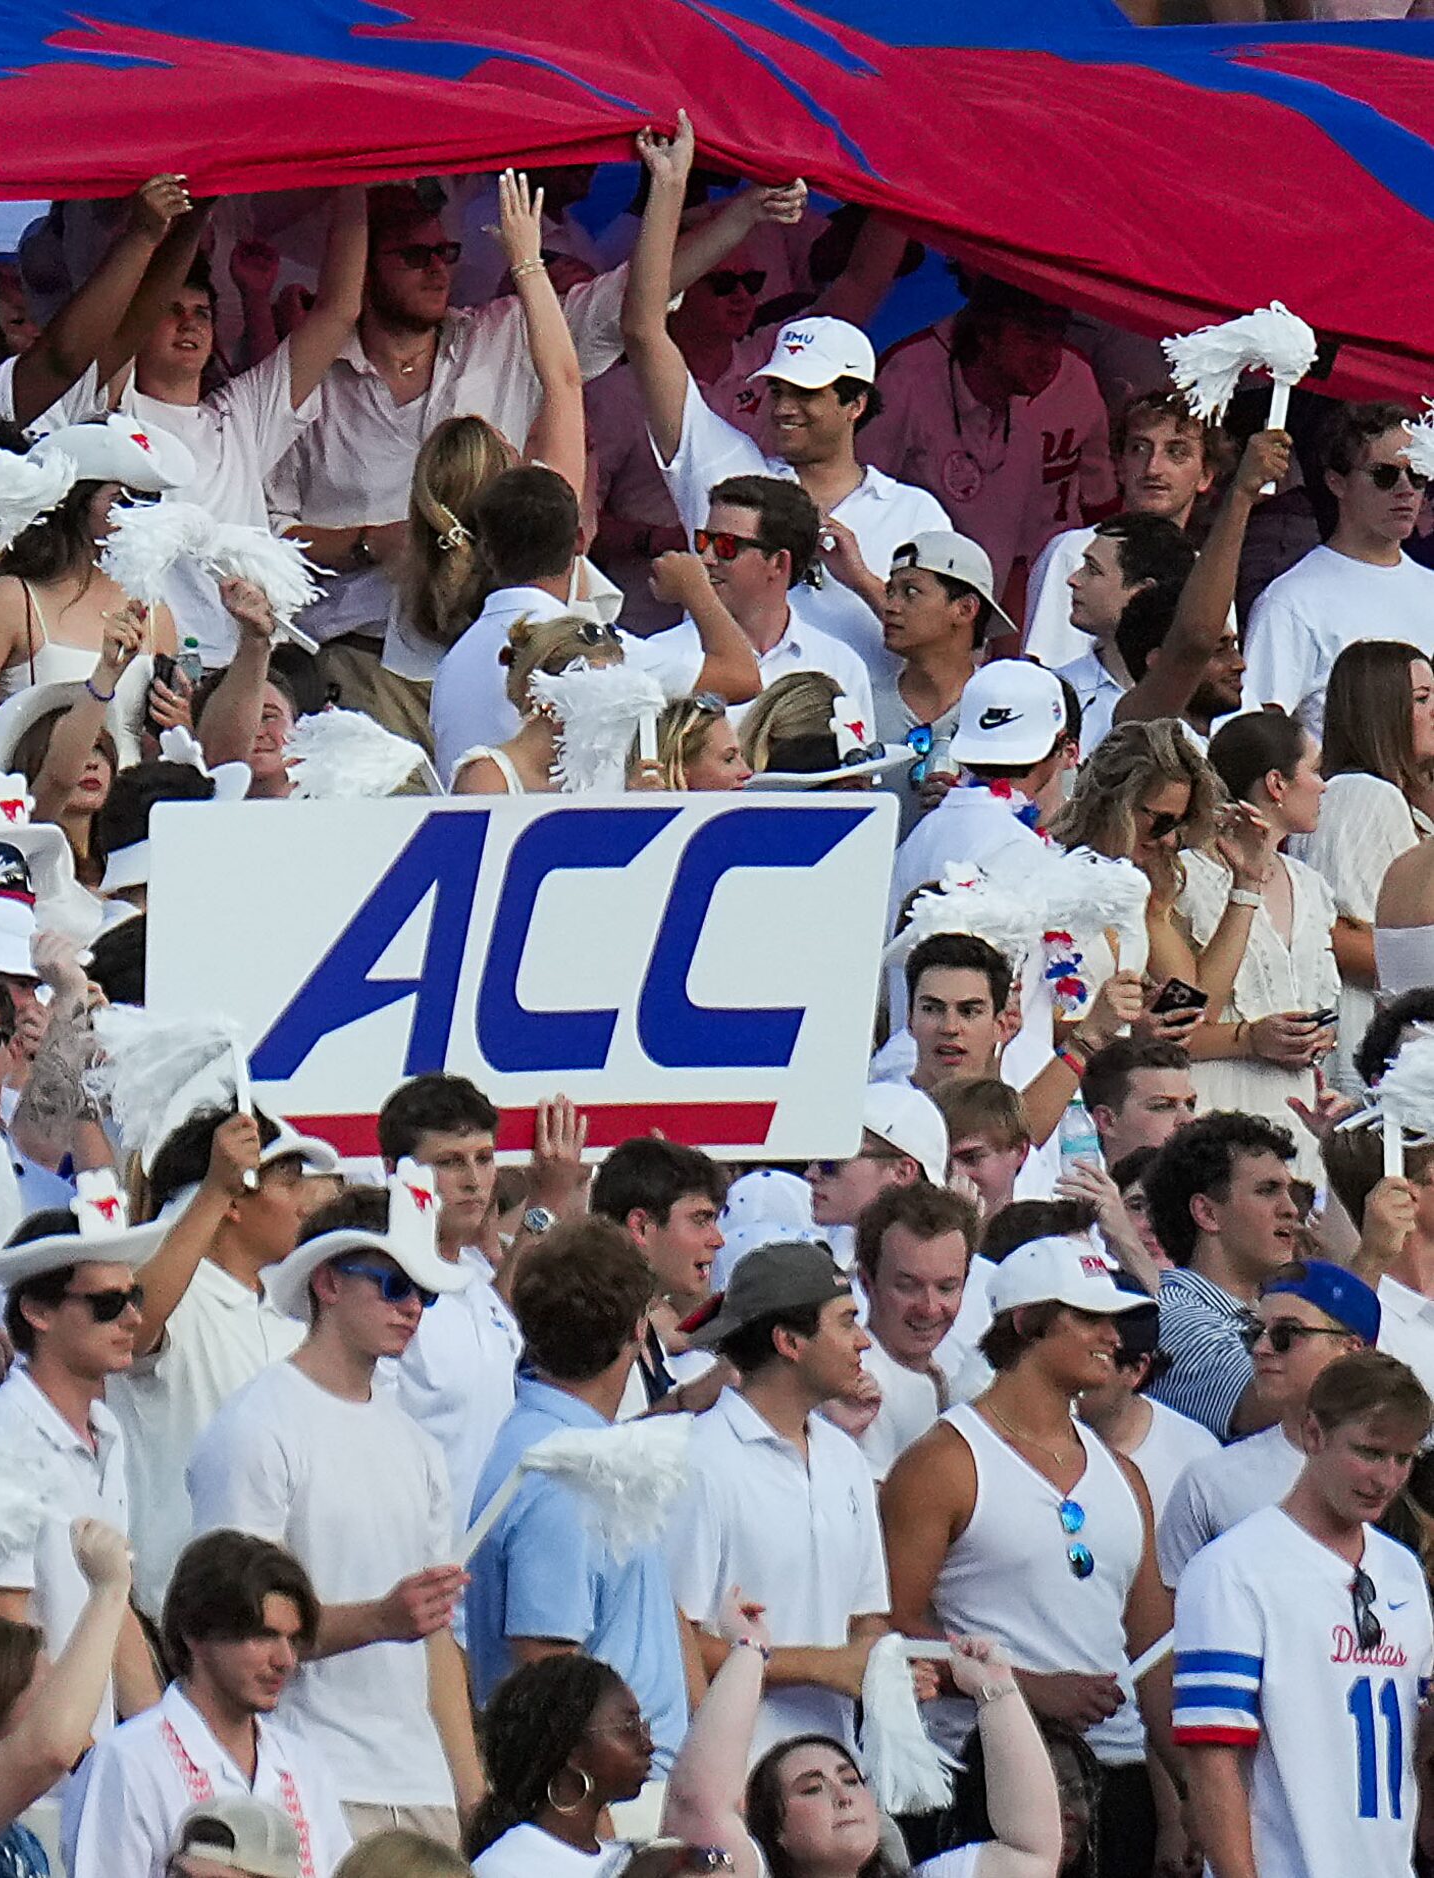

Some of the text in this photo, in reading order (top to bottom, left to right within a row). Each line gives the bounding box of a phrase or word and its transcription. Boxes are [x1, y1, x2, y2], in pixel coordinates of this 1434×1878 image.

[783, 331, 815, 345] SMU
[249, 806, 878, 1082] ACC
[1346, 1675, 1403, 1820] 11
